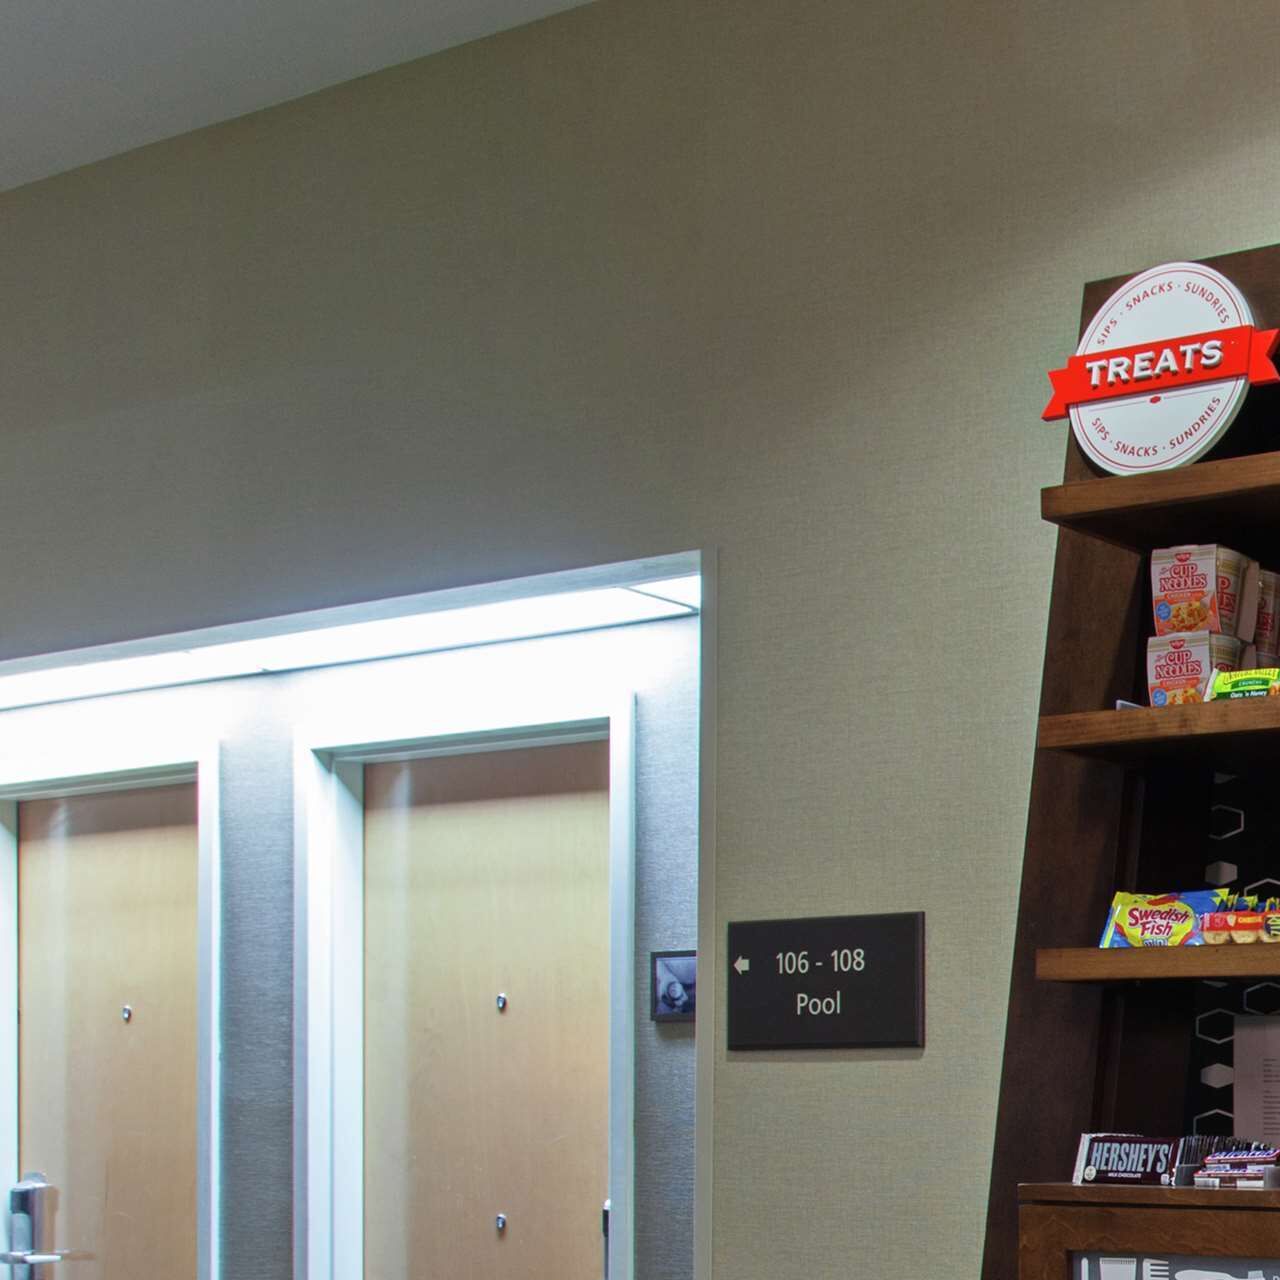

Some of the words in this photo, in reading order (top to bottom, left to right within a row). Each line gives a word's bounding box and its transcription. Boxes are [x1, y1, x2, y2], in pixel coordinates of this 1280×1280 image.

[1097, 318, 1117, 345] SIPS
[1125, 281, 1174, 311] SNACKS
[1184, 280, 1230, 323] SUNDRIES
[1085, 339, 1223, 388] TREATS
[1091, 417, 1110, 441] SIPS
[1114, 440, 1158, 457] SNACKS
[1169, 396, 1221, 450] SUNDRIES
[1170, 563, 1197, 577] CUP
[1160, 574, 1207, 592] NOODLES
[1166, 650, 1192, 665] CUP
[1155, 661, 1202, 680] NOODLES
[1128, 907, 1190, 928] Swedish
[1140, 920, 1172, 936] Fish
[775, 951, 809, 974] 106
[830, 949, 865, 972] 108
[796, 991, 841, 1015] Pool
[1091, 1142, 1169, 1172] HERSHEY'S
